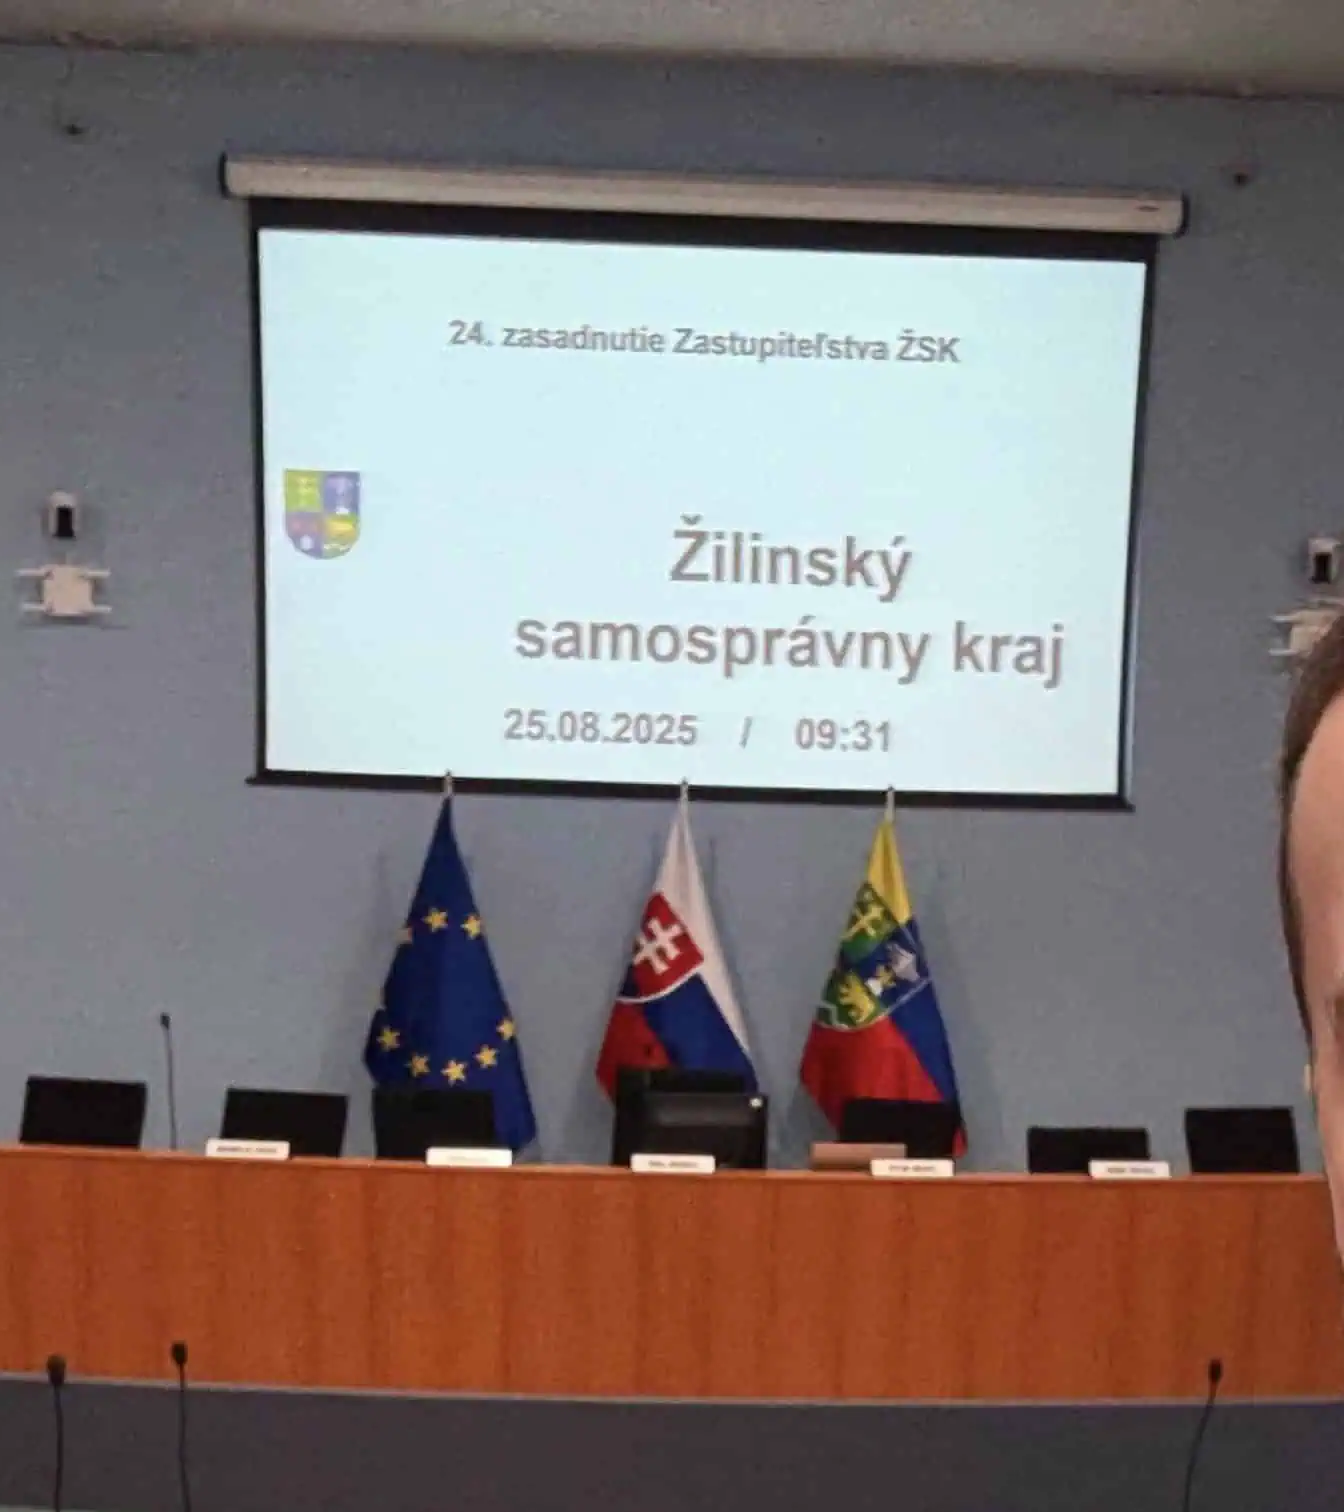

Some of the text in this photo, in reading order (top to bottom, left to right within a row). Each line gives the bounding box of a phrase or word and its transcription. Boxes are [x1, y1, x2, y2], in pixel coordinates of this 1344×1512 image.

[448, 319, 961, 362] 24. zasadnutie Zastupiteľstva ŽSK
[669, 514, 912, 602] Žilinský
[514, 615, 1066, 689] samosprávny kraj
[503, 708, 893, 752] 25.08.2025 / 09:31
